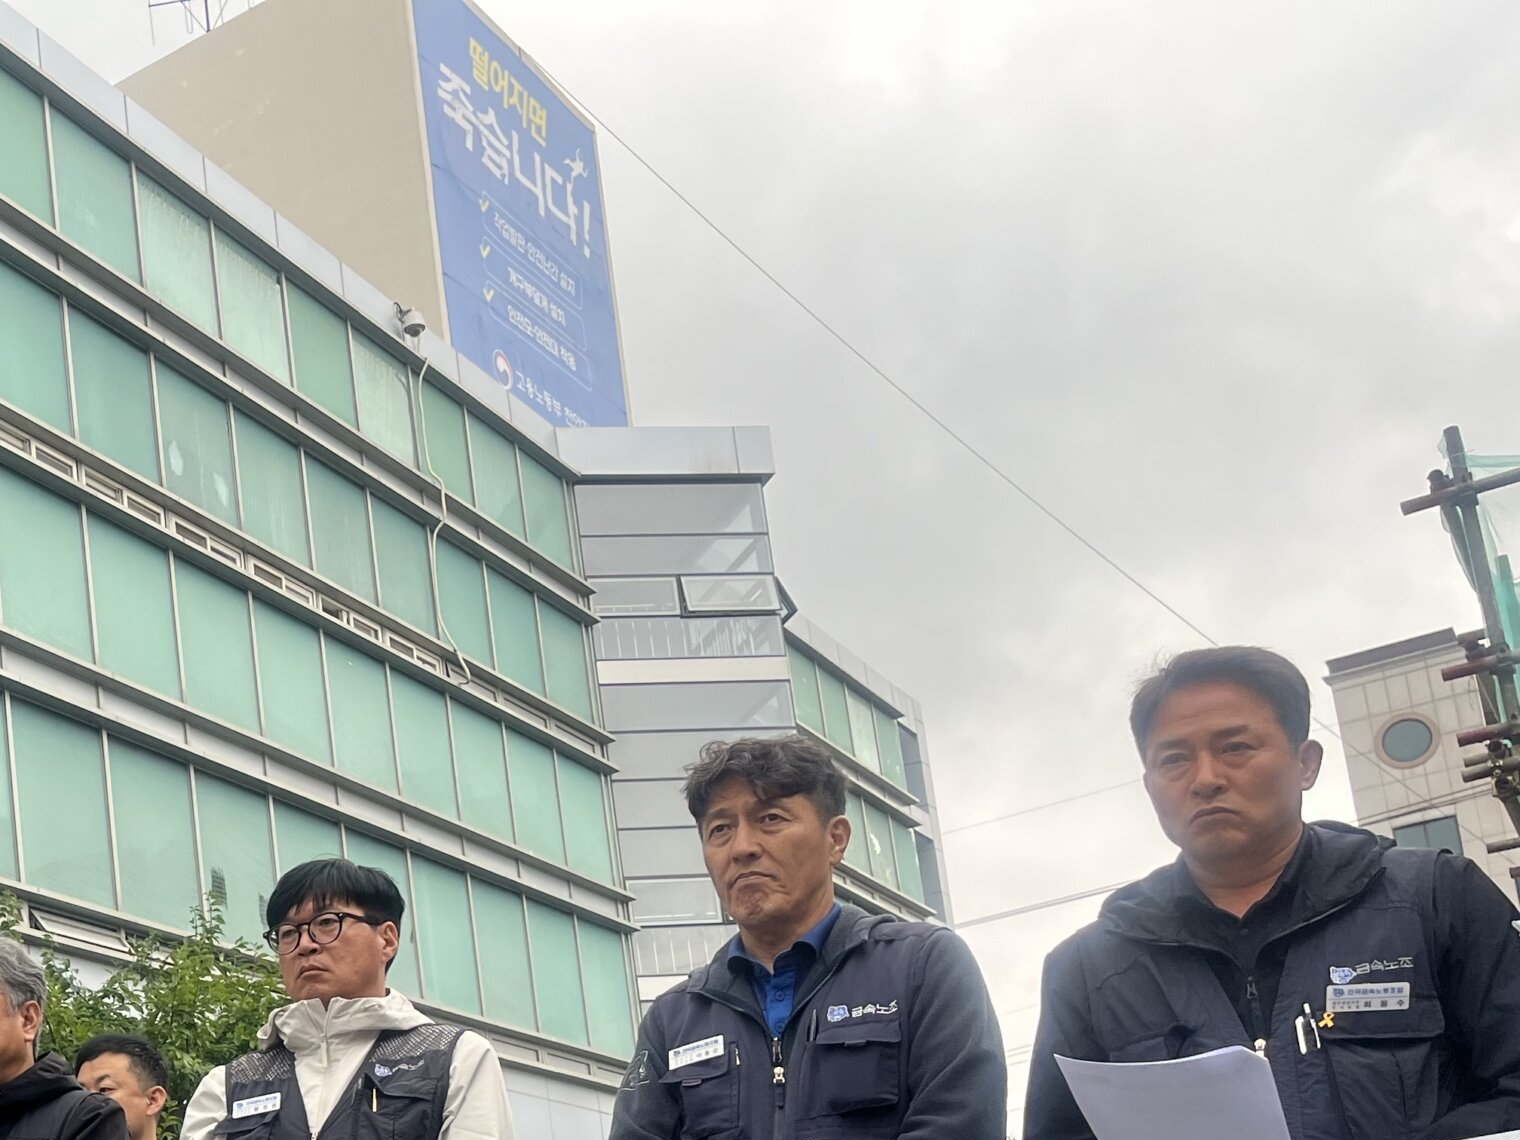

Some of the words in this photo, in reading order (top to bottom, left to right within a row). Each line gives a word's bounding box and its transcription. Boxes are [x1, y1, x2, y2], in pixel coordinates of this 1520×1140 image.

[469, 36, 547, 148] 떨어지면
[437, 62, 590, 259] 죽습니다!
[515, 370, 562, 417] 고용노동부
[1355, 957, 1414, 974] 금속노조
[851, 999, 898, 1018] 금속노조
